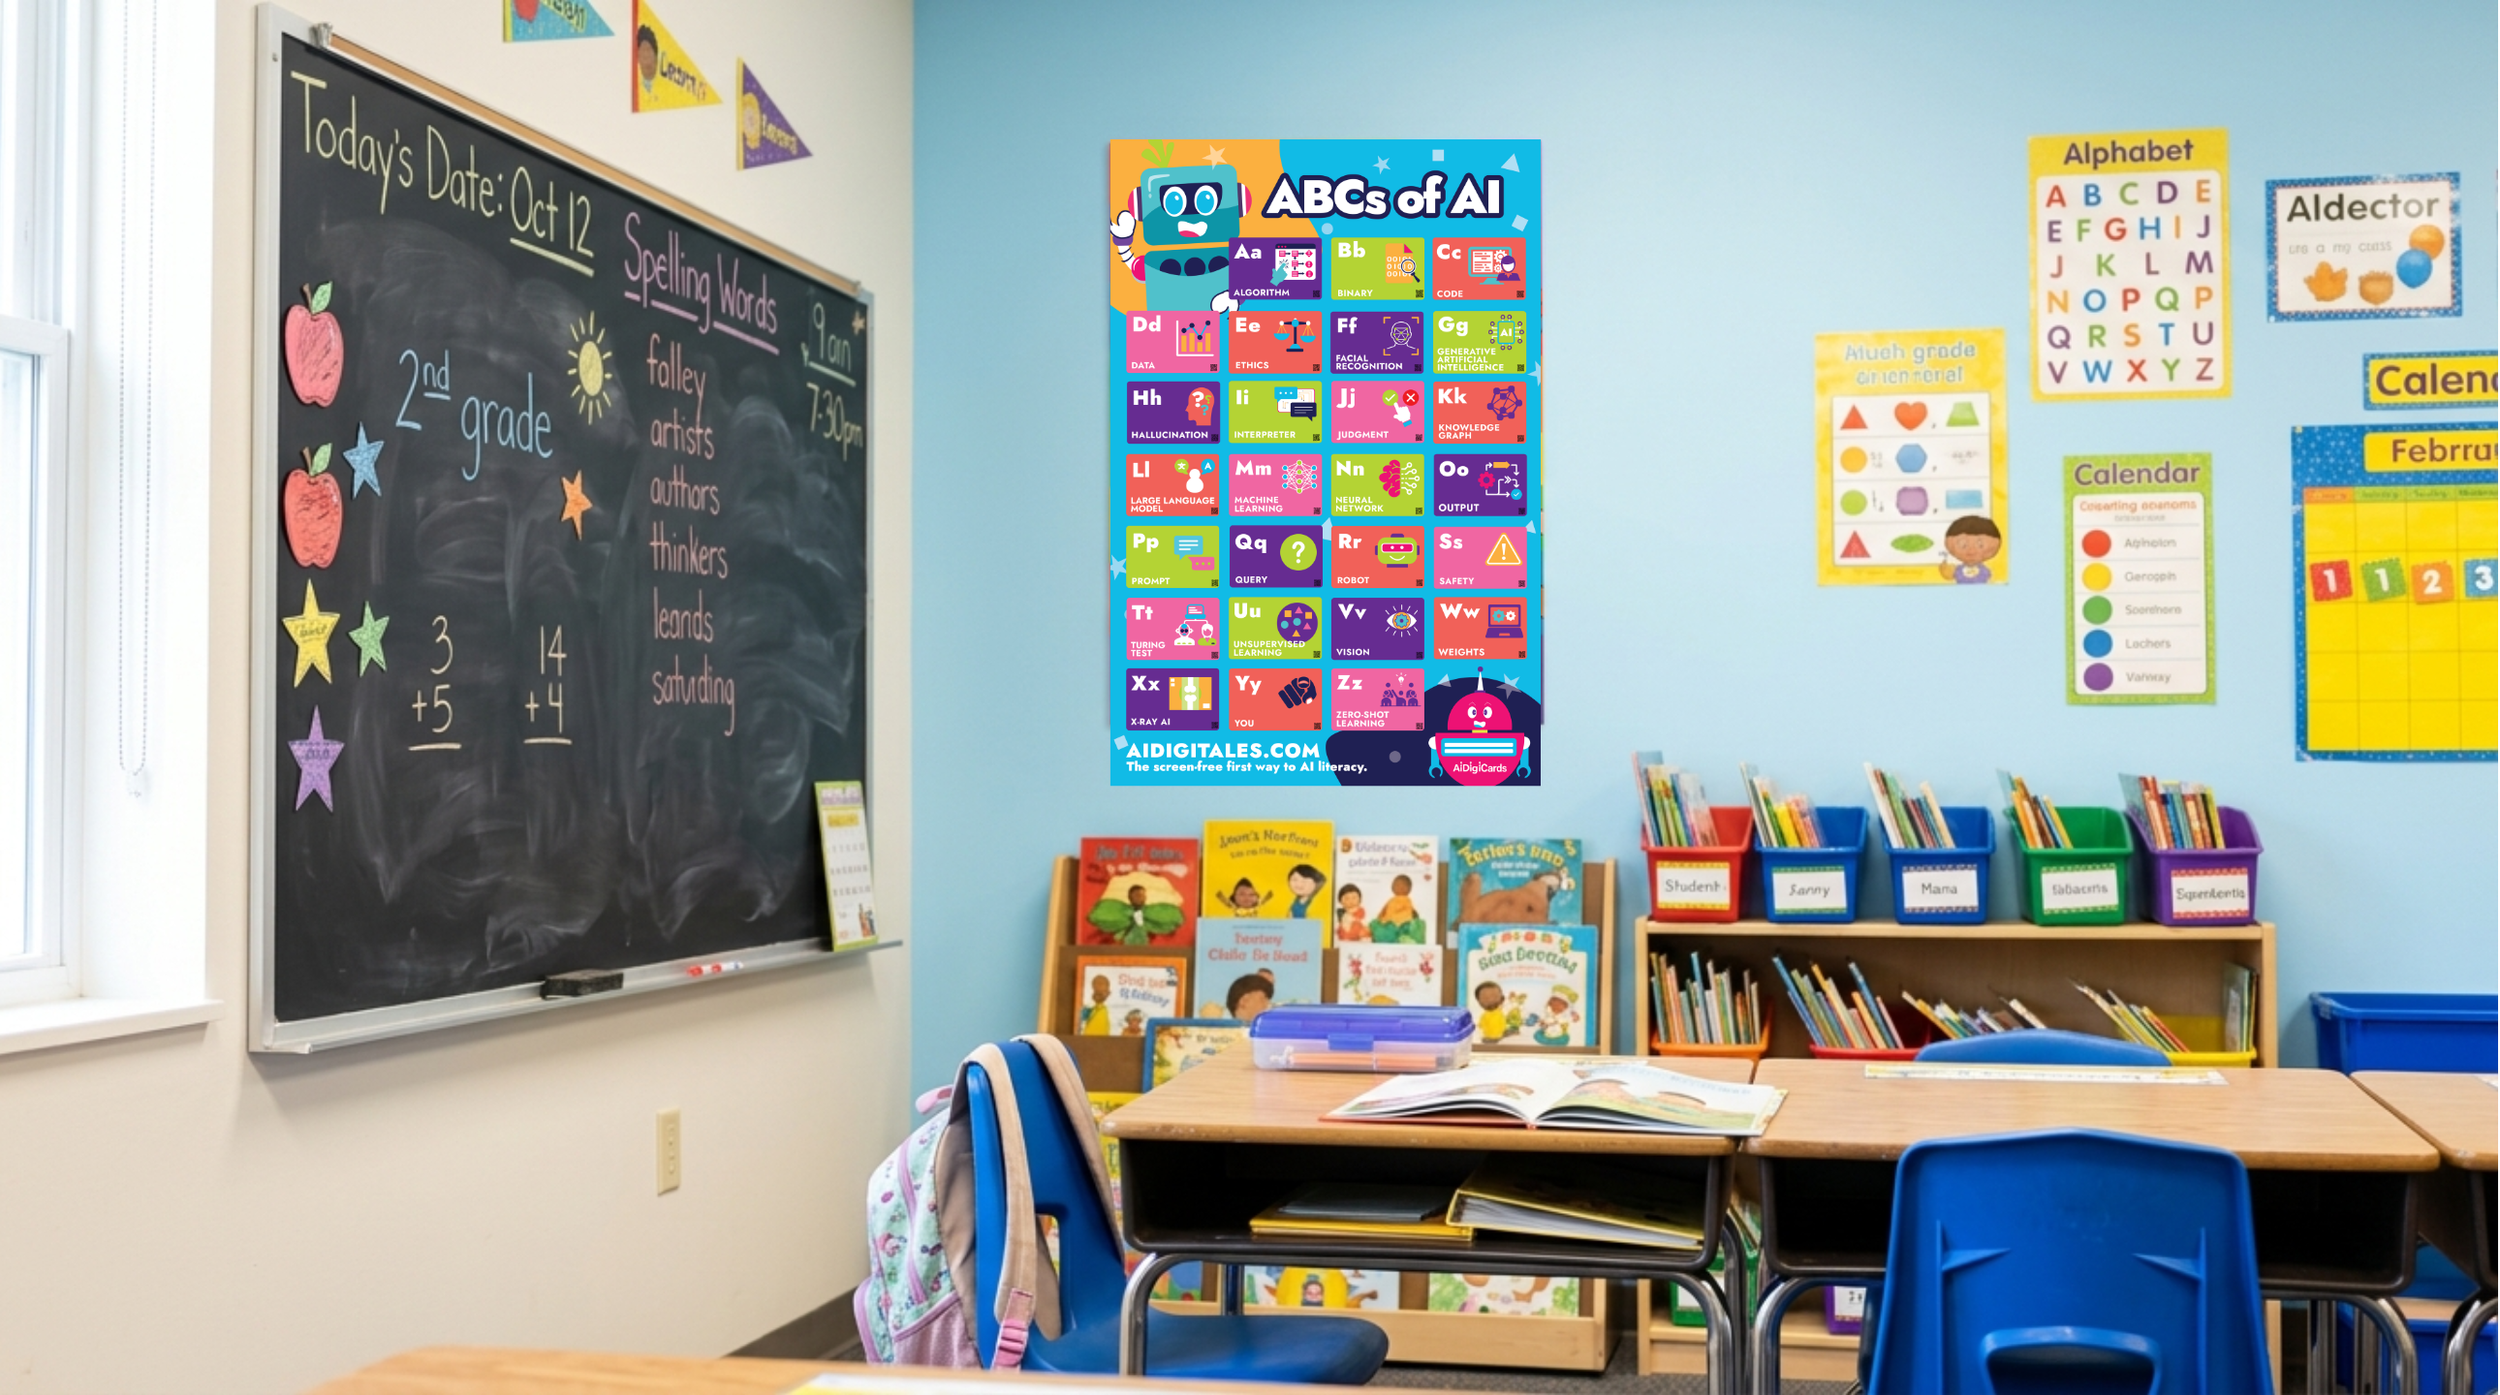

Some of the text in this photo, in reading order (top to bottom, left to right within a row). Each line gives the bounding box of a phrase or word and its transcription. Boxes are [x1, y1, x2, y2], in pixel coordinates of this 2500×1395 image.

[2064, 139, 2193, 170] Alphabet
[291, 72, 414, 214] Today's
[511, 167, 558, 242] Oct
[568, 190, 594, 258] 12
[1267, 175, 1499, 214] ABCs of AI
[2046, 180, 2210, 207] A B C D E
[2287, 193, 2439, 222] Aldector
[2048, 215, 2209, 242] E F G H I J
[1234, 244, 1261, 259] Aa
[1339, 241, 1365, 257] Bb
[1437, 244, 1461, 259] Cc
[2050, 251, 2213, 278] J K L M
[624, 212, 778, 334] Spelling Words
[1233, 288, 1290, 297] ALGORITHM
[1338, 289, 1373, 298] BINARY
[1437, 290, 1463, 298] CODE
[2048, 286, 2213, 313] N O P Q P
[1134, 315, 1160, 331] Dd
[1236, 318, 1260, 332] Ee
[1338, 317, 1357, 333] Ff
[1439, 317, 1468, 336] Gg
[813, 303, 827, 361] 9
[2048, 322, 2213, 349] Q R S T U
[1336, 354, 1369, 362] FACIAL
[1437, 348, 1496, 356] GENERATIVE
[1131, 361, 1155, 369] DATA
[1235, 361, 1269, 369] ETHICS
[1336, 362, 1403, 371] RECOGNITION
[1437, 364, 1504, 372] INTELLIGENCE
[2048, 358, 2213, 383] V W X Y Z
[647, 333, 707, 421] falley
[1134, 389, 1161, 405] Hh
[1336, 388, 1355, 408] Jj
[1439, 387, 1466, 403] Kk
[461, 373, 554, 480] grade
[651, 404, 715, 460] artists
[1438, 424, 1500, 432] KNOWLEDGE
[1131, 431, 1208, 439] HALLUCINATION
[1234, 431, 1296, 439] INTERPRETER
[1337, 431, 1389, 440] JUDGMENT
[1438, 432, 1472, 440] GRAPH
[2392, 438, 2498, 463] Febrru
[1236, 460, 1271, 475] Mm
[1337, 461, 1364, 475] Nn
[1440, 461, 1468, 476] Oo
[2075, 461, 2200, 486] Calendar
[650, 464, 720, 515] authors
[1131, 496, 1215, 505] LARGE LANGUAGE
[1234, 496, 1279, 504] MACHINE
[1335, 496, 1373, 504] NEURAL
[1131, 504, 1163, 513] MODEL
[1234, 504, 1283, 513] LEARNING
[1335, 504, 1384, 512] NETWORK
[1439, 503, 1479, 512] OUTPUT
[1134, 533, 1159, 552] Pp
[1235, 534, 1266, 553] Qq
[1339, 534, 1361, 548] Rr
[1440, 534, 1462, 549] Ss
[650, 522, 728, 578] thinkers
[1132, 577, 1170, 585] PROMPT
[1236, 575, 1268, 585] QUERY
[1337, 576, 1370, 585] ROBOT
[1440, 577, 1474, 585] SAFETY
[2323, 566, 2493, 594] 1 1 2 3
[654, 588, 714, 643] leands
[1132, 605, 1153, 620] Tt
[1235, 603, 1260, 618] Uu
[1338, 604, 1366, 619] Vv
[1440, 604, 1480, 618] Ww
[431, 616, 453, 674] 3
[539, 625, 567, 677] 14
[1131, 641, 1166, 649] TURING
[1234, 640, 1305, 648] UNSUPERVISED
[1131, 649, 1152, 657] TEST
[1234, 648, 1282, 657] LEARNING
[1336, 648, 1370, 656] VISION
[1438, 648, 1485, 656] WEIGHTS
[1132, 676, 1159, 690] Xx
[1235, 676, 1261, 695] Yy
[1337, 675, 1362, 689] Zz
[1336, 710, 1389, 719] ZERO-SHOT
[1161, 718, 1171, 726] AI
[1235, 719, 1255, 727] YOU
[1336, 719, 1386, 727] LEARNING
[1126, 743, 1320, 759] AIDIGITALES.COM
[1126, 761, 1149, 771] The
[1227, 761, 1251, 771] first
[1254, 763, 1280, 775] way
[1281, 761, 1296, 772] to
[1300, 762, 1314, 772] AI
[1319, 761, 1367, 774] literacy.
[1453, 762, 1507, 774] AiDigiCards
